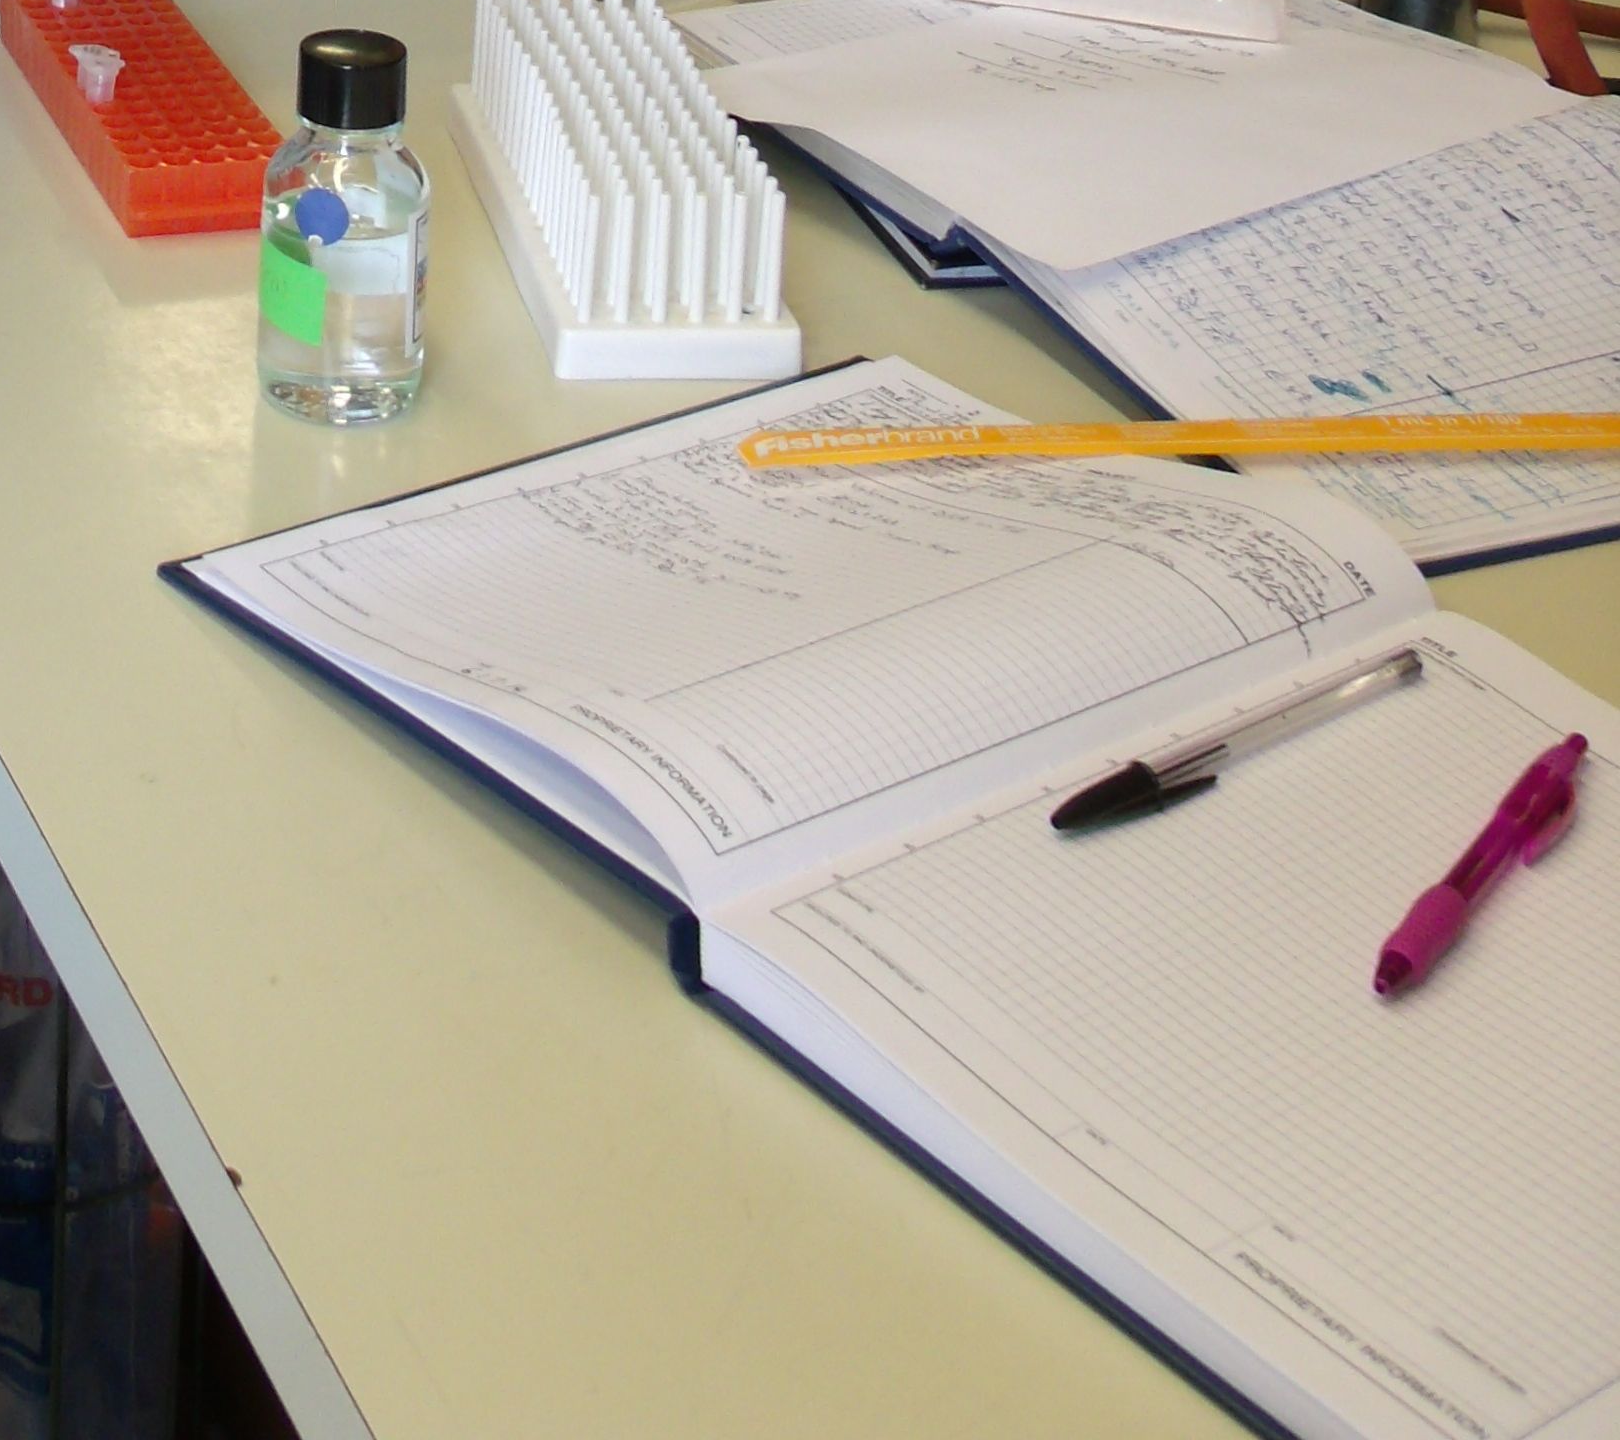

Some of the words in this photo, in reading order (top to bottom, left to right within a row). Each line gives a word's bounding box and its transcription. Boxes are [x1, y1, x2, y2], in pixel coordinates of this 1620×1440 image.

[754, 426, 980, 458] Fisherbrand
[1343, 560, 1377, 599] DATE
[570, 703, 654, 755] PROPRIETARY
[650, 752, 733, 839] INFORMATION
